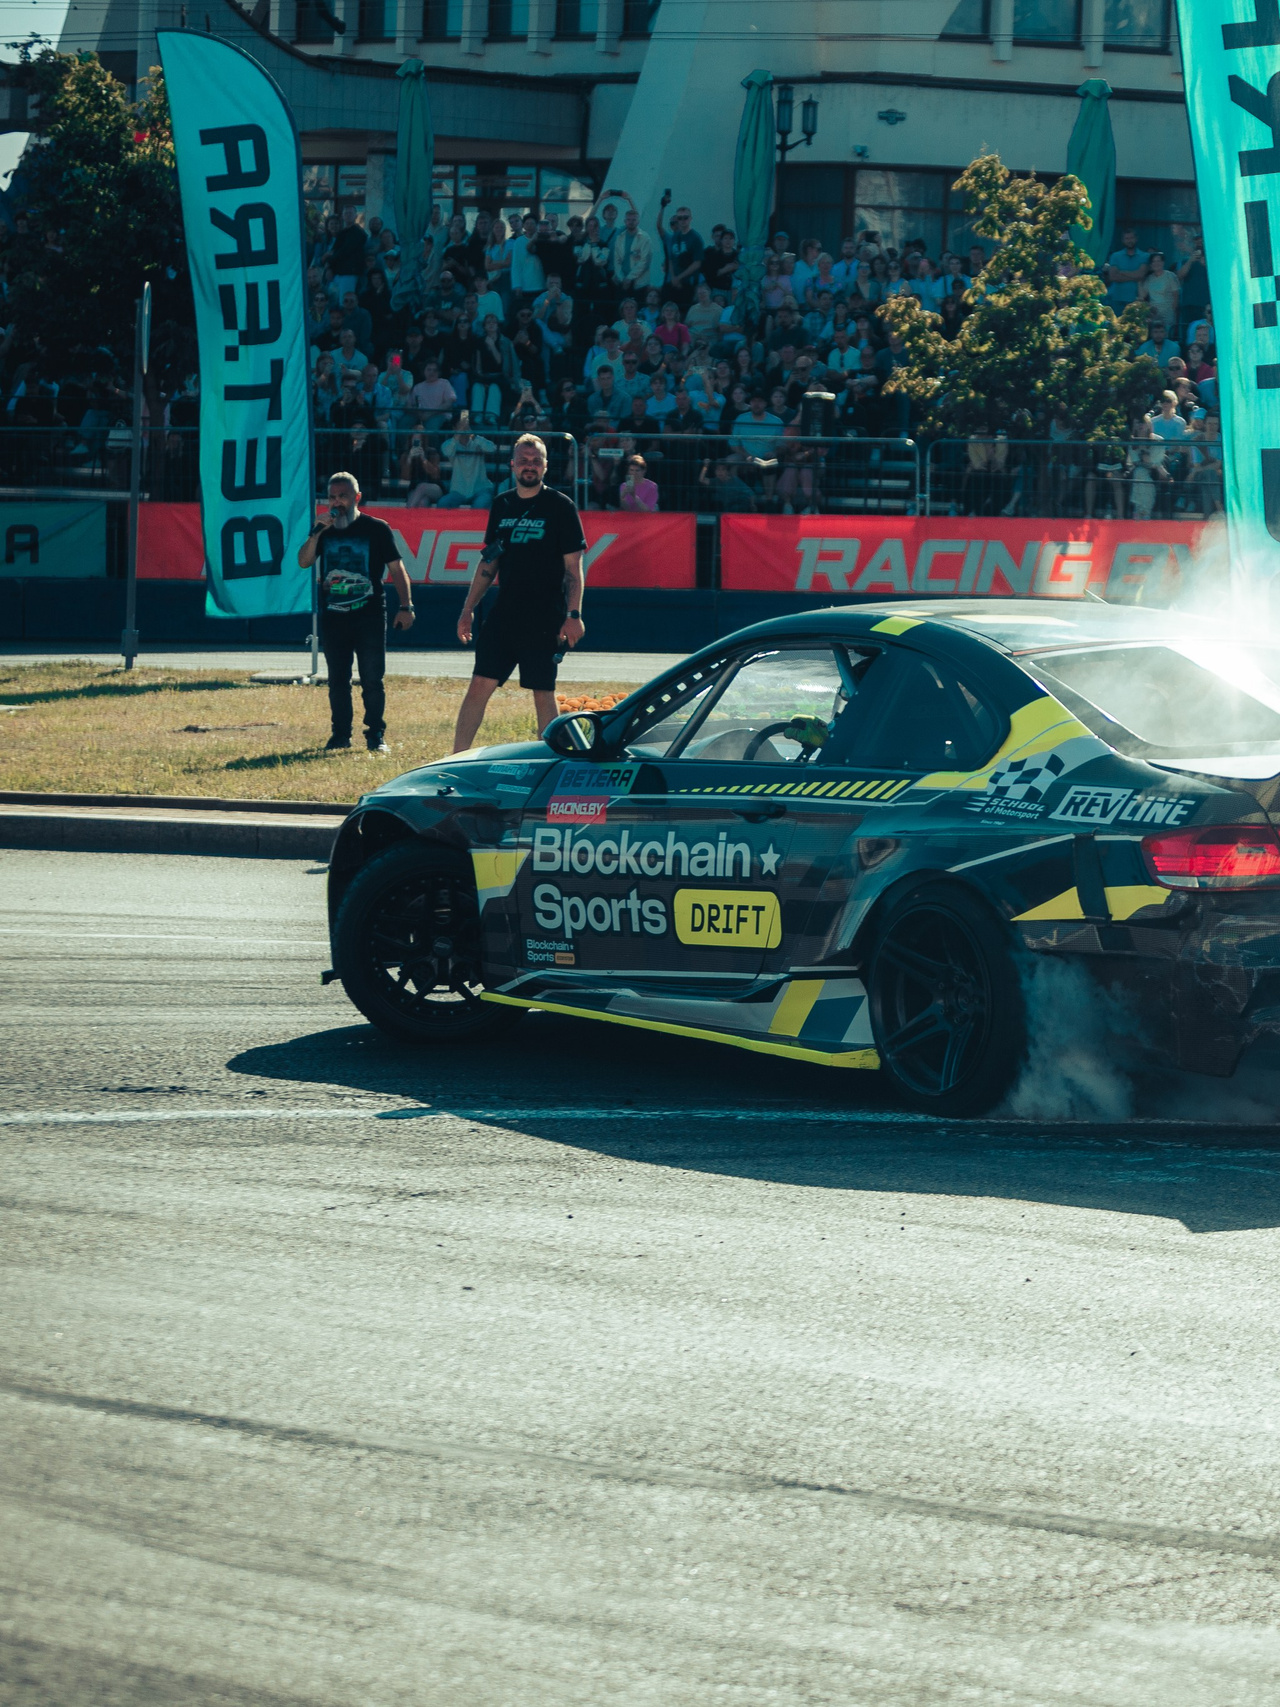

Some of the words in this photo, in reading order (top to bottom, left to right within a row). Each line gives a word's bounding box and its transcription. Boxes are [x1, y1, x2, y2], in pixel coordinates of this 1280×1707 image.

[510, 527, 545, 543] GP
[550, 802, 605, 816] RACING.BY
[989, 798, 1046, 812] SCHOOL
[994, 807, 1040, 819] Motorsport
[532, 827, 751, 878] Blockchain
[533, 883, 668, 938] Sports
[691, 903, 766, 935] DRIFT
[526, 939, 570, 951] Blockchain
[527, 950, 555, 963] Sports
